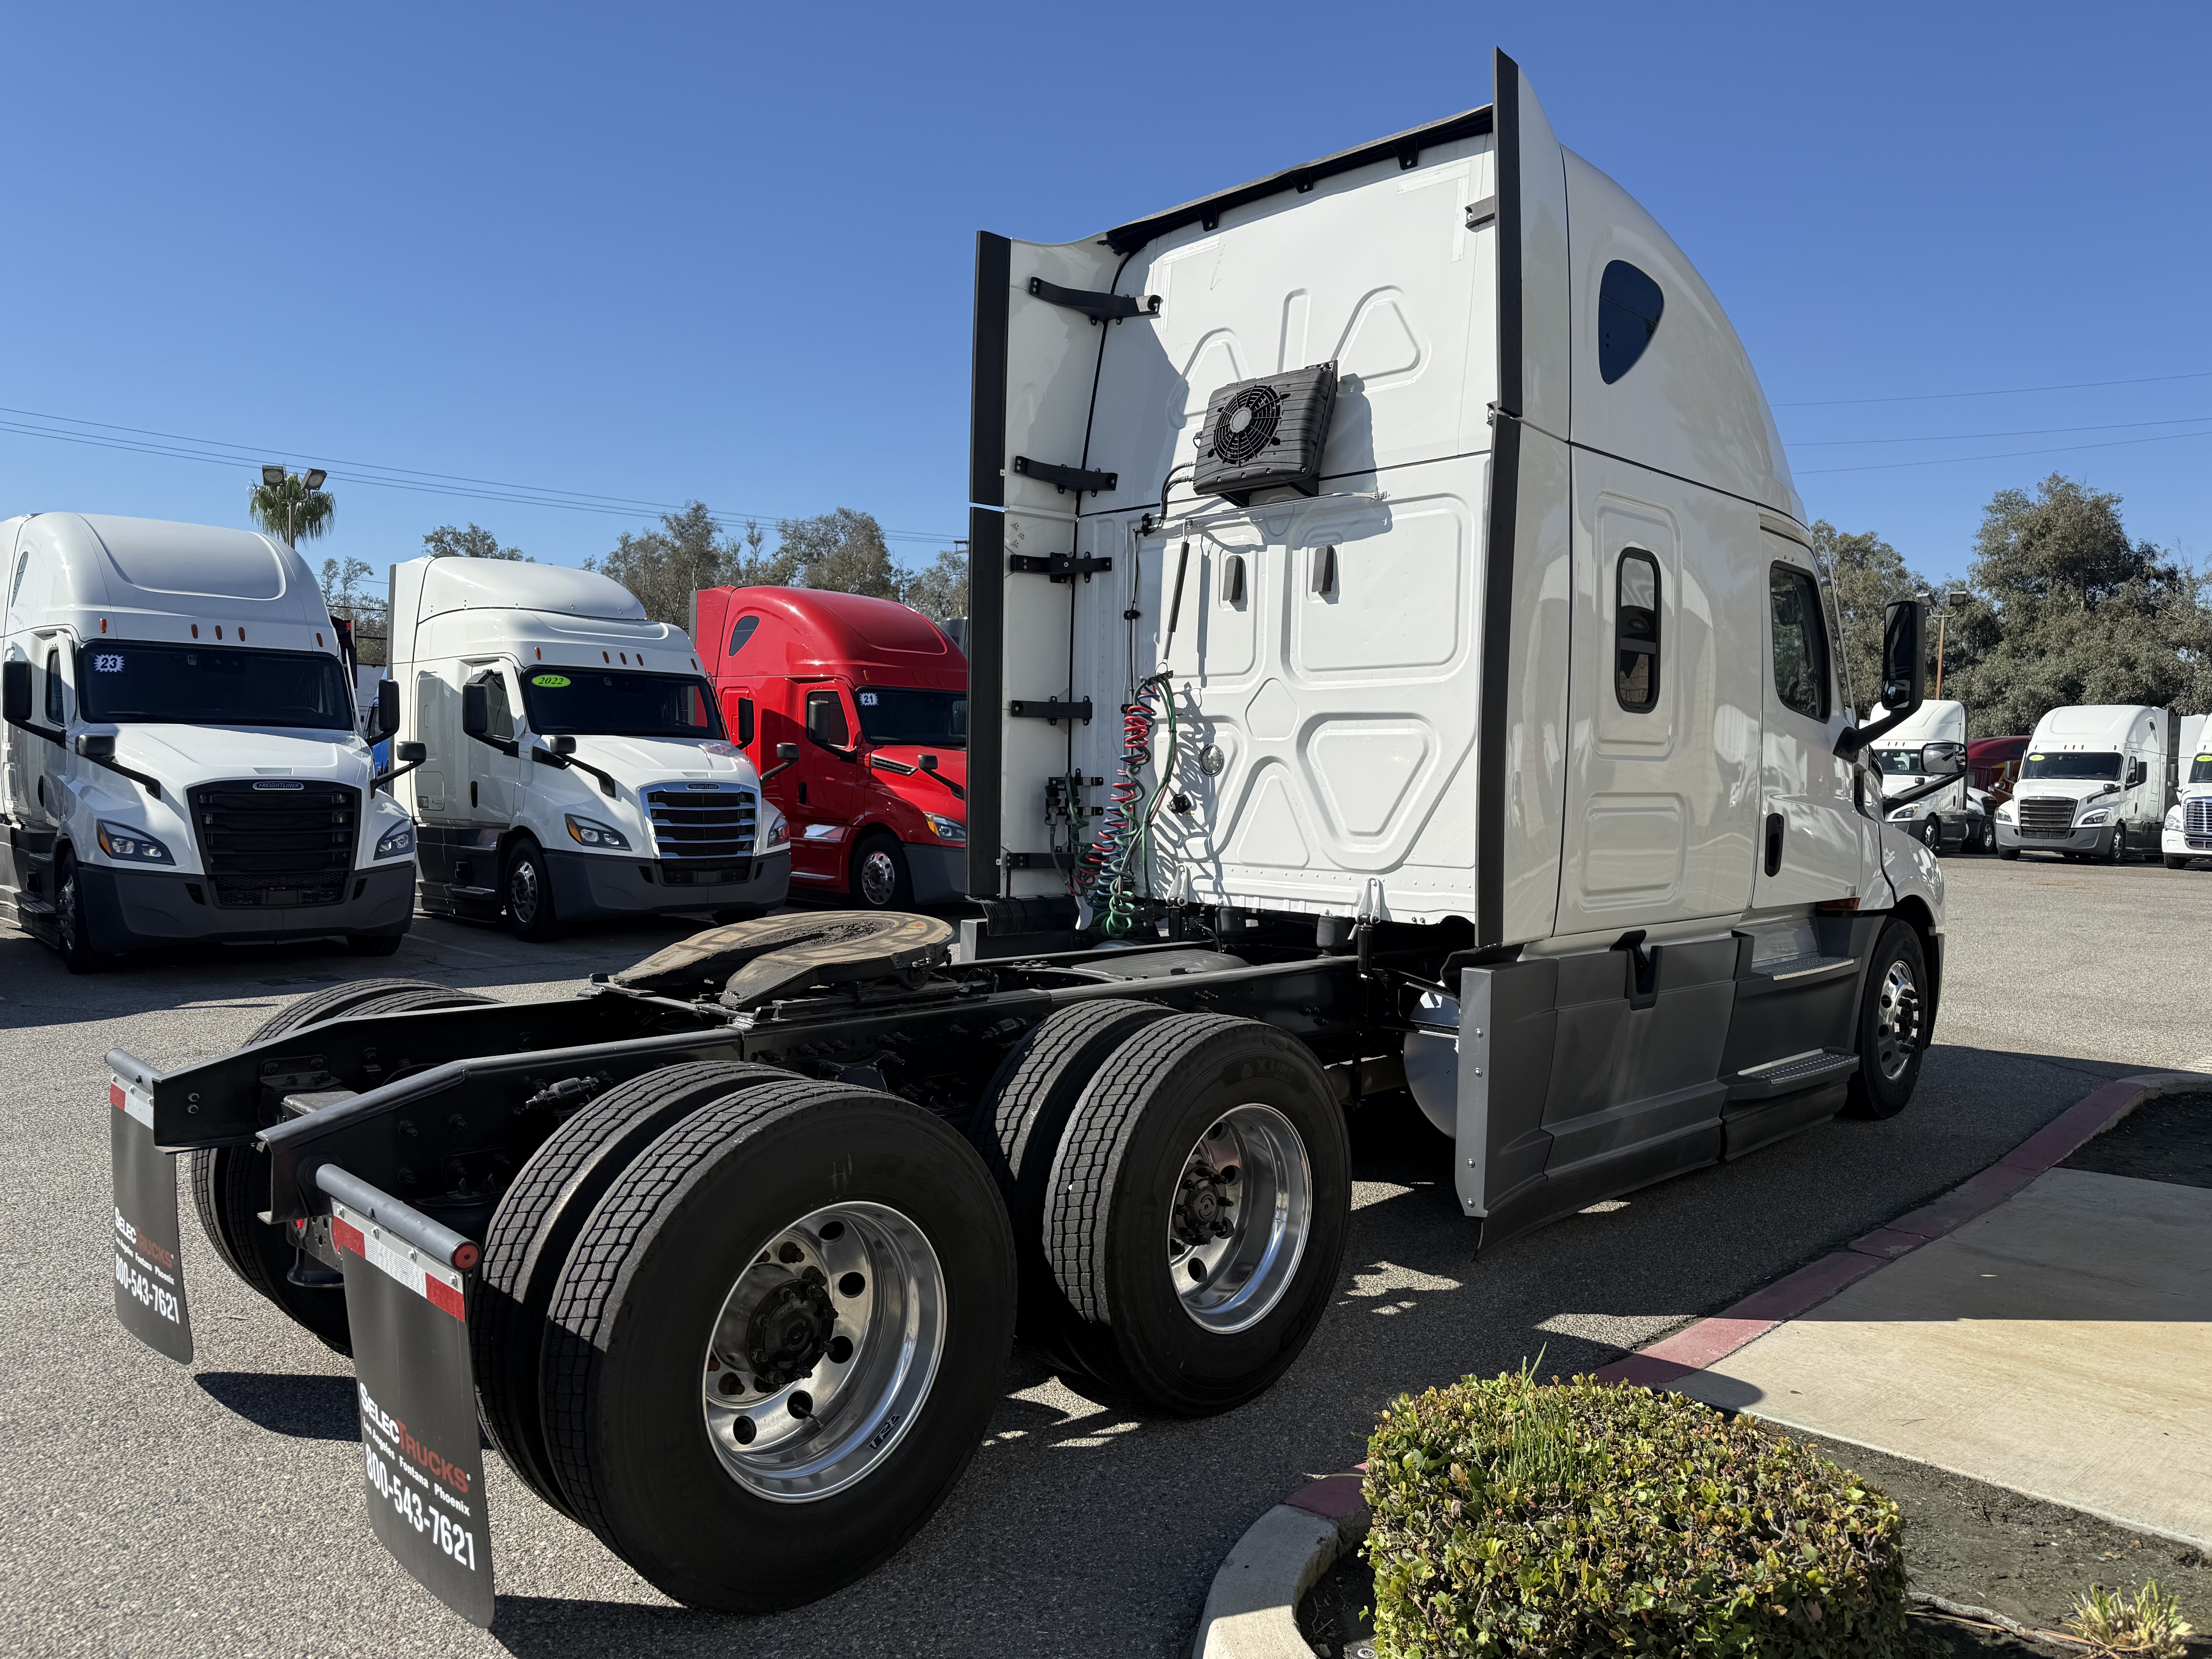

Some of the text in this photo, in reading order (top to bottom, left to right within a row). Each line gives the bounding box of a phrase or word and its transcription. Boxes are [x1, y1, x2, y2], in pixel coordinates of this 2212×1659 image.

[100, 657, 117, 669] 23
[864, 695, 873, 703] 21
[116, 1253, 180, 1324] 800-543-7621
[155, 1265, 175, 1285] Phoenix
[363, 1416, 470, 1517] Los Angeles Fontana Phoenix
[366, 1443, 475, 1571] 800-543-7621
